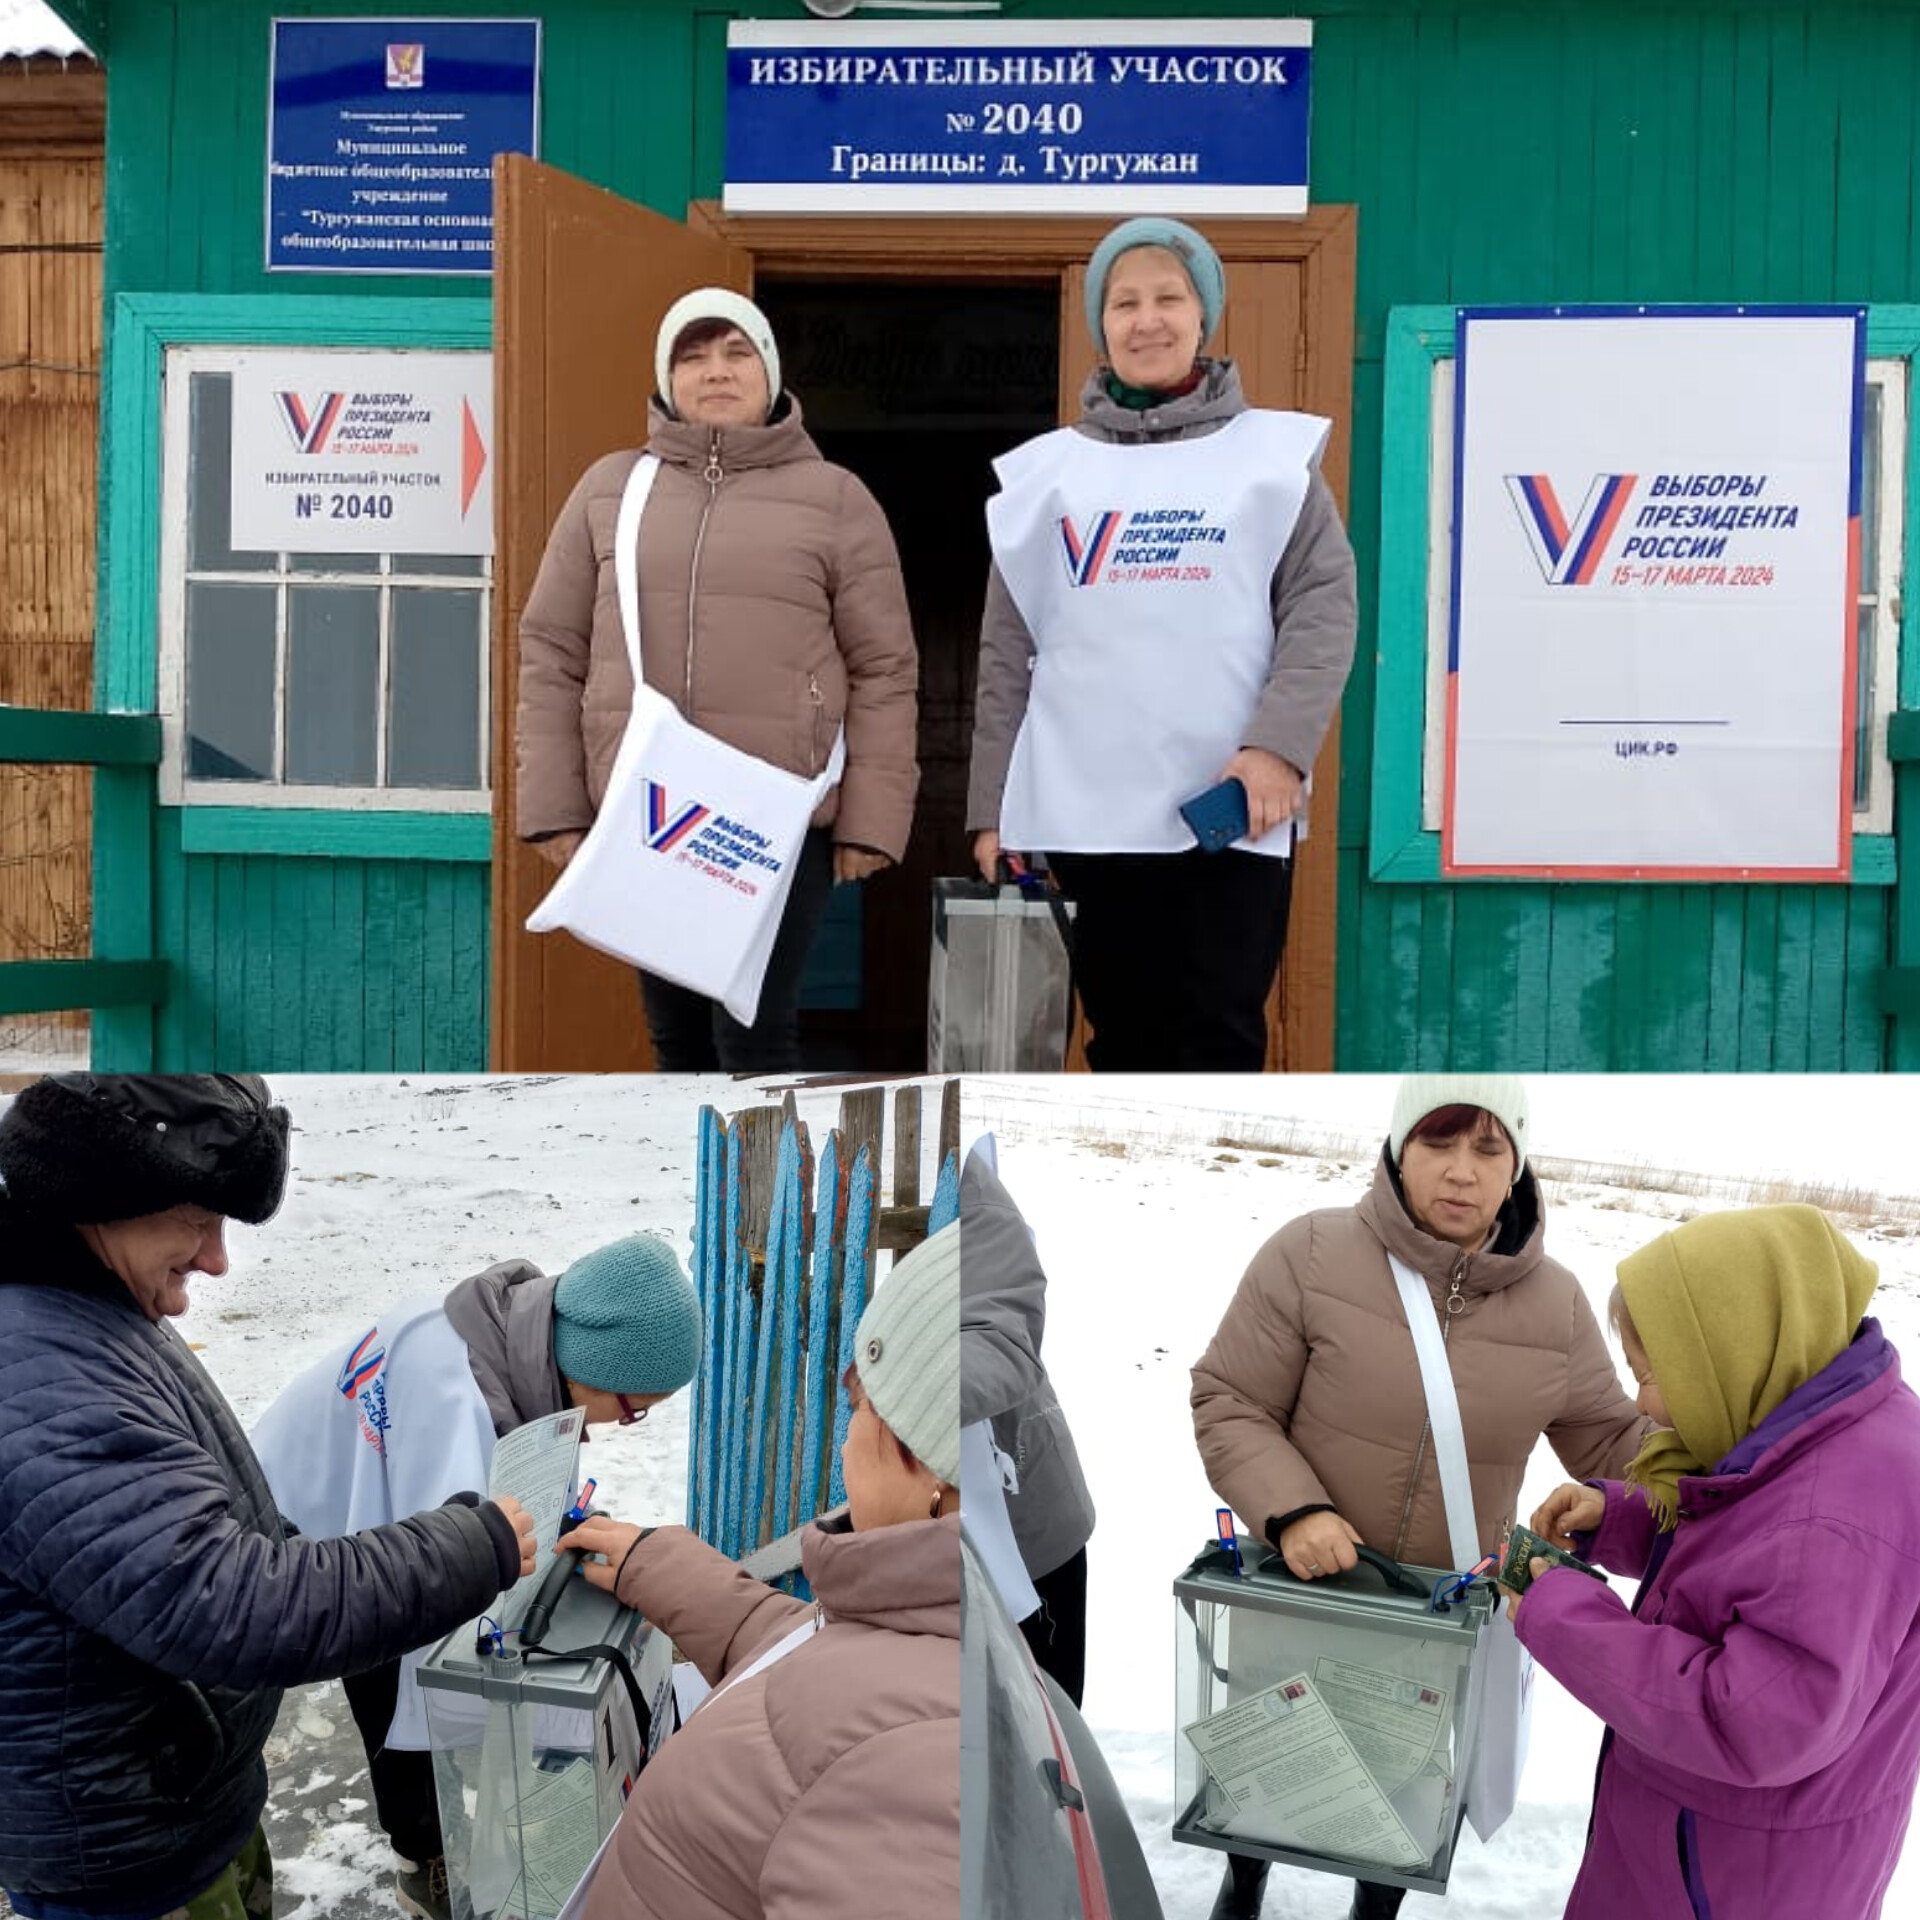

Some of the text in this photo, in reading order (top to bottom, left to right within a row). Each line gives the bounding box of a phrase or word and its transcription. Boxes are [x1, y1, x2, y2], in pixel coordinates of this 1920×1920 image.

[750, 51, 1287, 85] ИЗБИРАТЕЛЬНЫЙ УЧАСТОК
[946, 103, 1082, 134] № 2040
[336, 139, 467, 157] Муниципальное
[831, 145, 1198, 180] Границы: д. Тургужан
[352, 189, 448, 204] учреждение
[461, 238, 495, 251] шко
[351, 393, 413, 406] ВЫБОРЫ
[345, 410, 431, 424] ПРЕЗИДЕНТА
[337, 427, 393, 439] РОССИИ
[265, 470, 441, 487] ИЗБИРАТЕЛЬНЫЙ УЧАСТОК
[1649, 474, 1767, 497] ВЫБОРЫ
[296, 494, 393, 519] № 2040
[1130, 509, 1206, 526] ВЫБОРЫ
[1636, 505, 1799, 530] ПРЕЗИДЕНТА
[1121, 527, 1226, 544] ПРЕЗИДЕНТА
[1113, 547, 1181, 564] РОССИИ
[1621, 536, 1728, 559] РОССИИ
[1140, 567, 1179, 581] МАРТА
[1180, 567, 1212, 580] 2024
[1662, 565, 1726, 586] МАРТА
[1728, 566, 1775, 586] 2024
[1615, 741, 1679, 759] ЦИК.РФ
[687, 839, 742, 870] РОССИИ
[699, 827, 783, 873] ПРЕЗИДЕНТА
